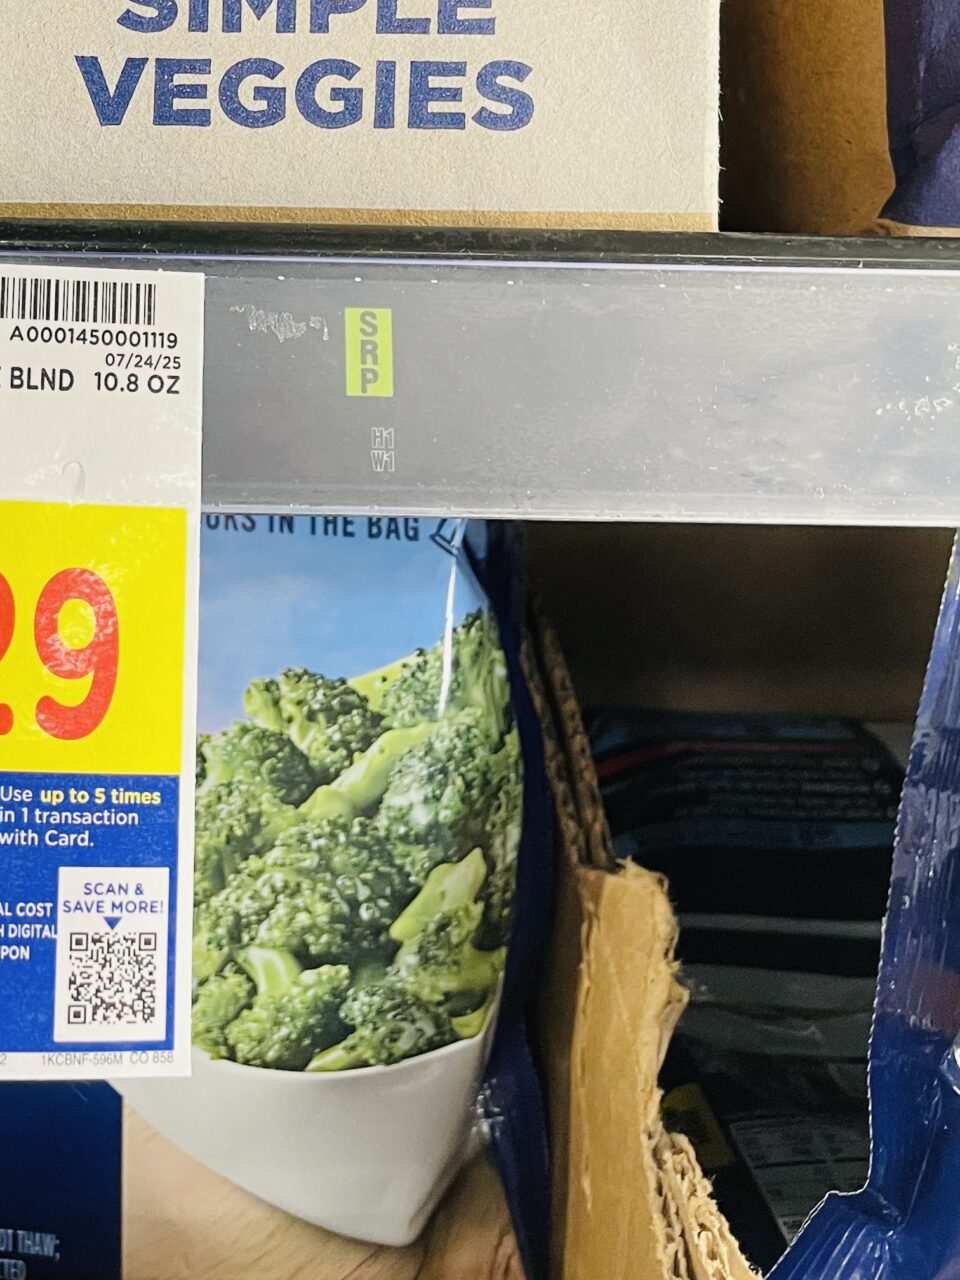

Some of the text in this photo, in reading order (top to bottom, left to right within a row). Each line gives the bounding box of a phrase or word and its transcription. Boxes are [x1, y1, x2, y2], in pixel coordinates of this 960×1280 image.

[74, 55, 535, 131] VEGGIES
[9, 325, 178, 349] A0001450001119
[105, 353, 182, 370] 07/24/25
[10, 367, 74, 391] BLND
[94, 371, 139, 392] 10.8
[147, 374, 181, 394] OZ
[308, 516, 356, 538] THE
[367, 517, 420, 542] BAG
[0, 786, 161, 808] Use up to 5 times
[21, 808, 28, 823] 1
[35, 808, 139, 826] transaction
[45, 829, 94, 847] Card.
[83, 882, 144, 895] SCAN &
[16, 902, 53, 917] COST
[62, 900, 164, 914] SAVE MORE!
[8, 924, 57, 939] DIGITAL
[152, 1051, 175, 1064] 858
